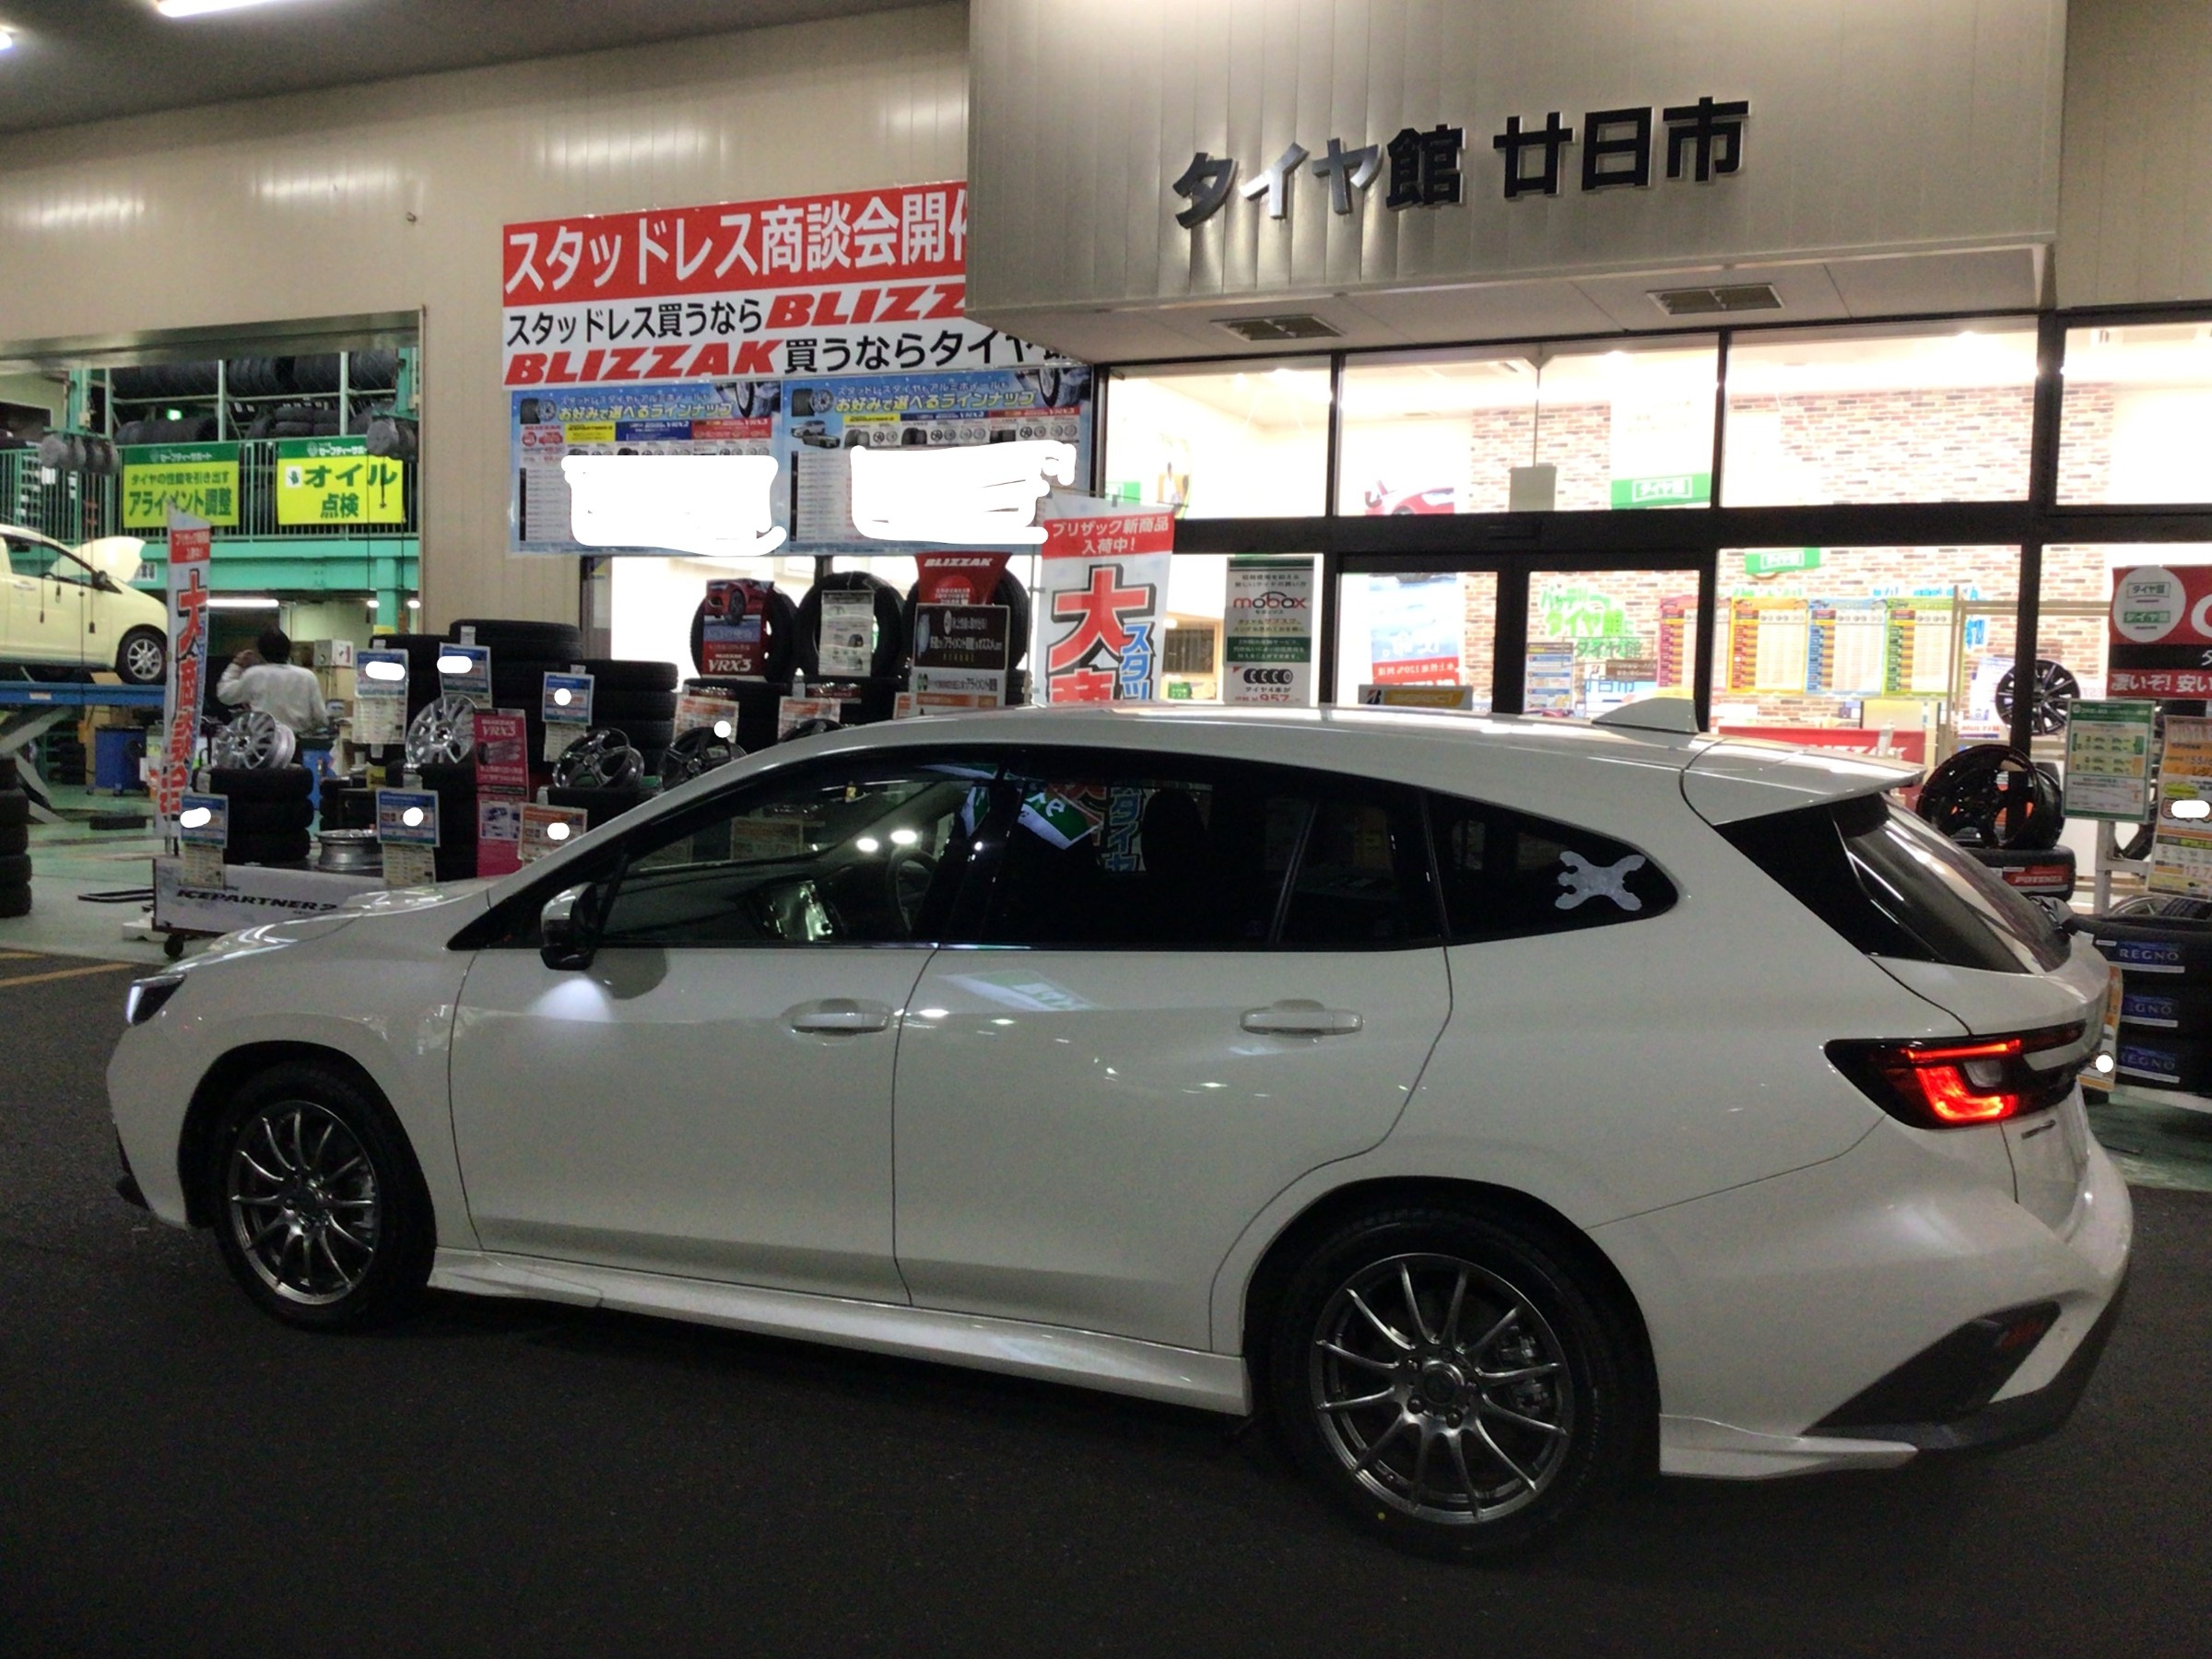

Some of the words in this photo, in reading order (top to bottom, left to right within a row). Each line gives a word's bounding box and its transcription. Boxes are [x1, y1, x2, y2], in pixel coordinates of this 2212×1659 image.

[1171, 124, 1467, 229] タイヤ館
[1492, 95, 1750, 201] 廿日市
[507, 297, 763, 347] スタッドレス買うなら
[503, 339, 783, 386] BLIZZAK
[834, 390, 1035, 413] お好みで選べるラインナップ
[303, 463, 398, 487] オイル
[320, 492, 360, 519] 点検
[1052, 514, 1171, 538] ブリザック新商品
[924, 557, 994, 567] BLIZZAK
[1233, 591, 1307, 608] mobox
[707, 659, 752, 673] VRX3
[2013, 875, 2065, 885] POTENZA
[175, 888, 319, 912] ICEPARTNER
[2120, 947, 2180, 961] REGNO
